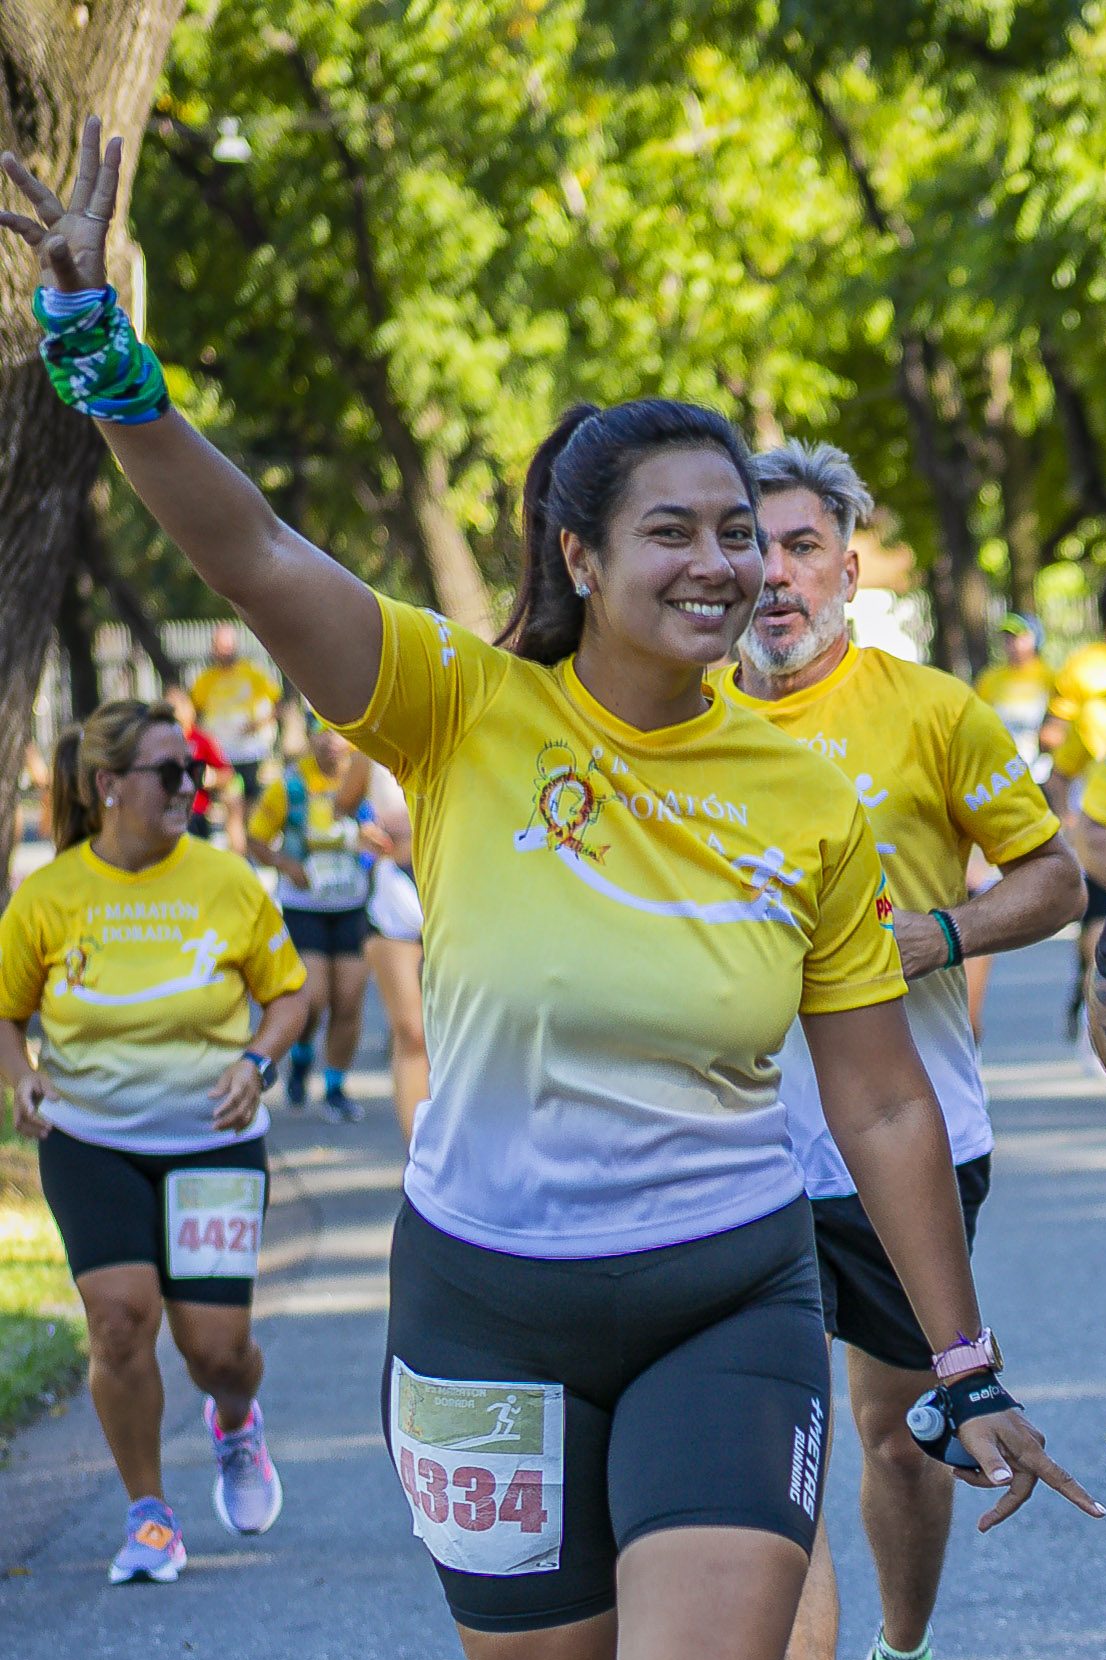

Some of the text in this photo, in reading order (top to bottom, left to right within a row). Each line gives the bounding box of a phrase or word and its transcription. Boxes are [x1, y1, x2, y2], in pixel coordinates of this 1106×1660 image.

[105, 896, 199, 922] MARATÓN
[102, 923, 183, 945] DORADA
[177, 1217, 259, 1254] 4421
[400, 1446, 548, 1534] 4334
